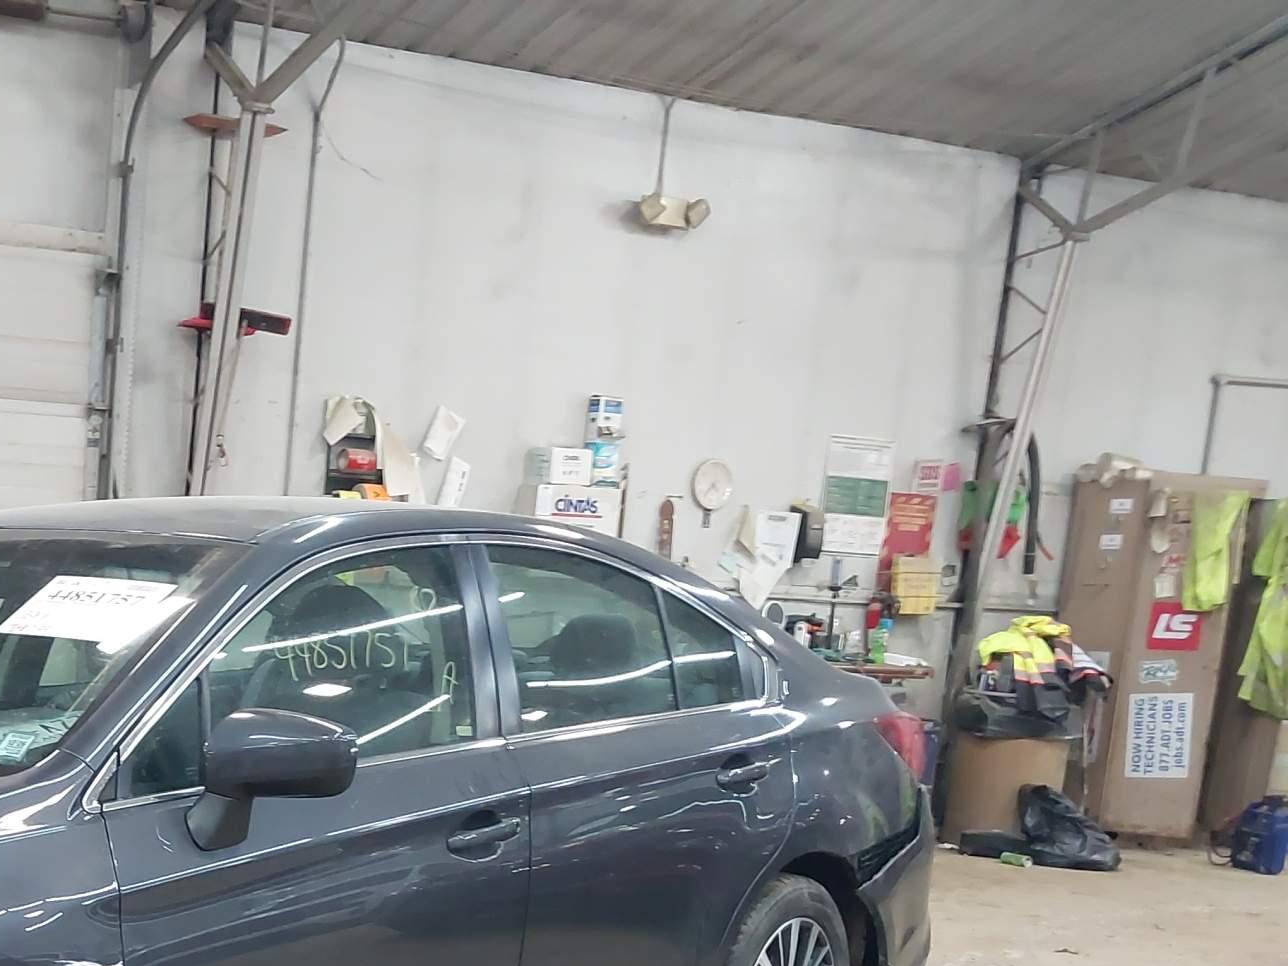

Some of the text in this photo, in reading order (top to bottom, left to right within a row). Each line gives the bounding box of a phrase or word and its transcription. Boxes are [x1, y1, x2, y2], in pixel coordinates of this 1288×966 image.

[554, 495, 599, 514] CINTAS
[1131, 698, 1145, 773] NOW HIRING
[1144, 696, 1158, 775] TECHNICIANS
